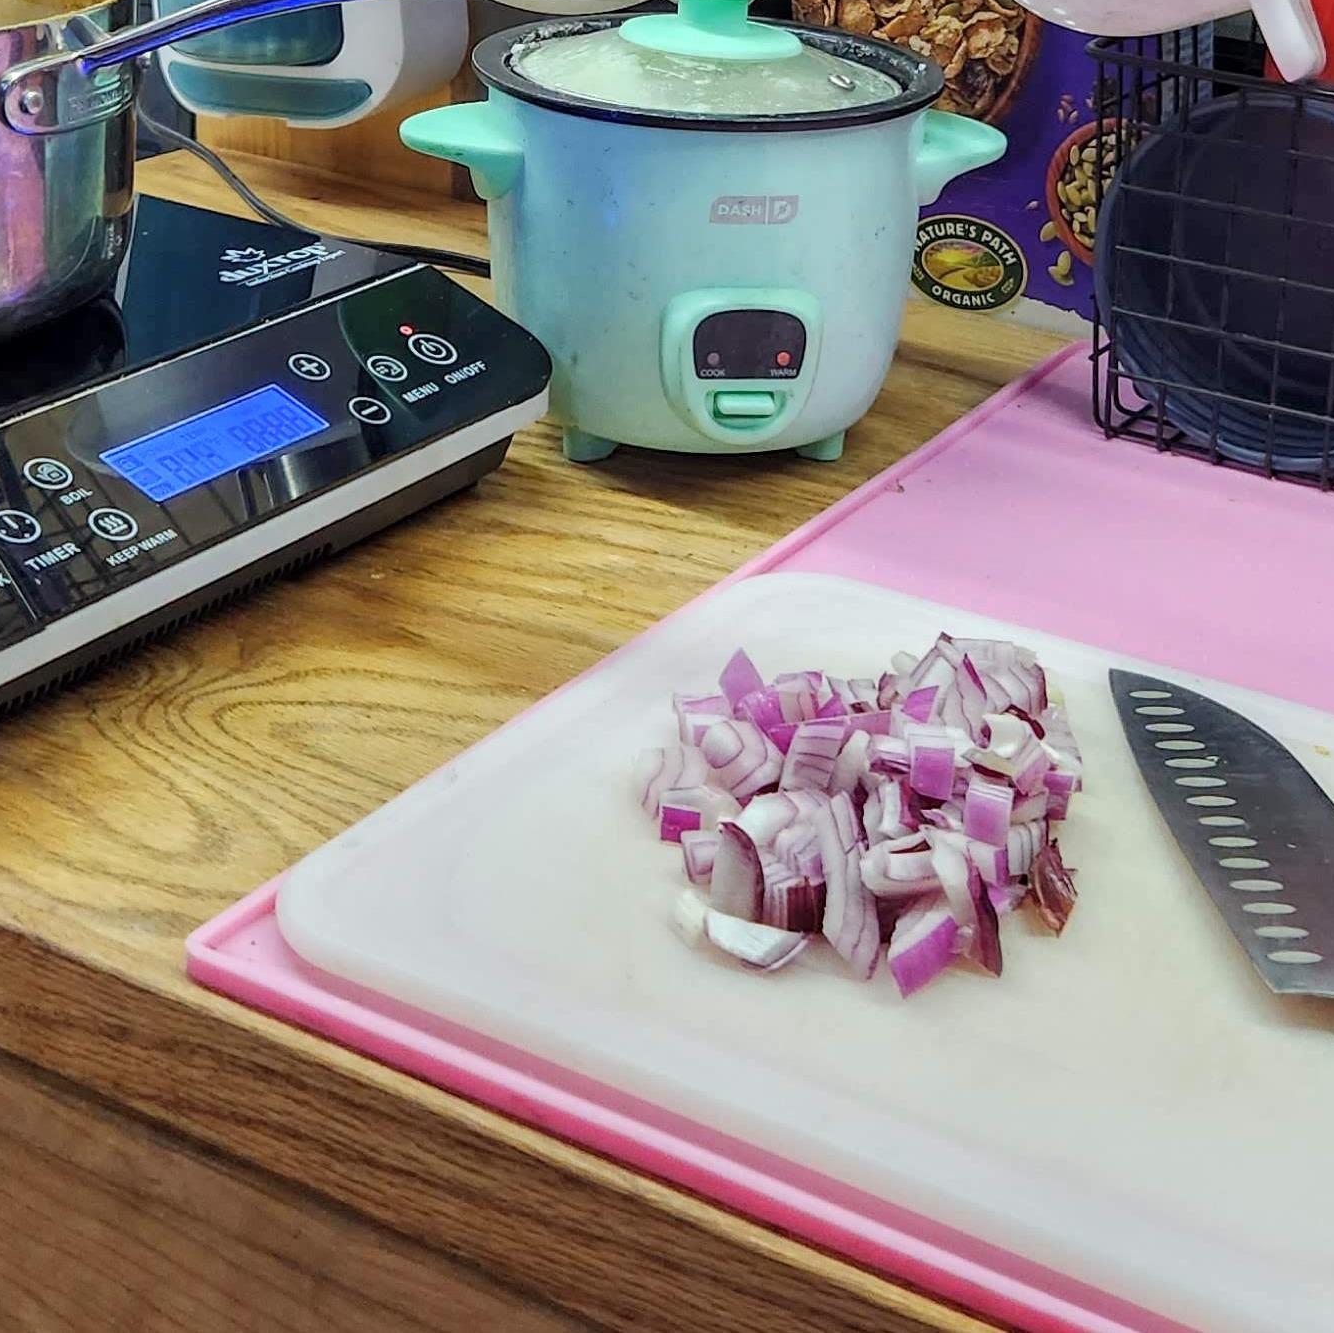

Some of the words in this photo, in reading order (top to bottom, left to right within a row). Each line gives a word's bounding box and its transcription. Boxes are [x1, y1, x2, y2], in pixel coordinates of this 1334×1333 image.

[717, 203, 763, 217] DASH
[980, 230, 1018, 265] PATH
[931, 284, 996, 307] ORGANIC
[443, 360, 487, 385] ON/OFF
[699, 368, 726, 377] COOK
[770, 368, 797, 377] WARM
[401, 381, 441, 404] MENU
[58, 487, 94, 507] BOIL
[23, 541, 82, 572] TIMER
[105, 545, 141, 567] KEEP
[139, 528, 179, 553] WARM
